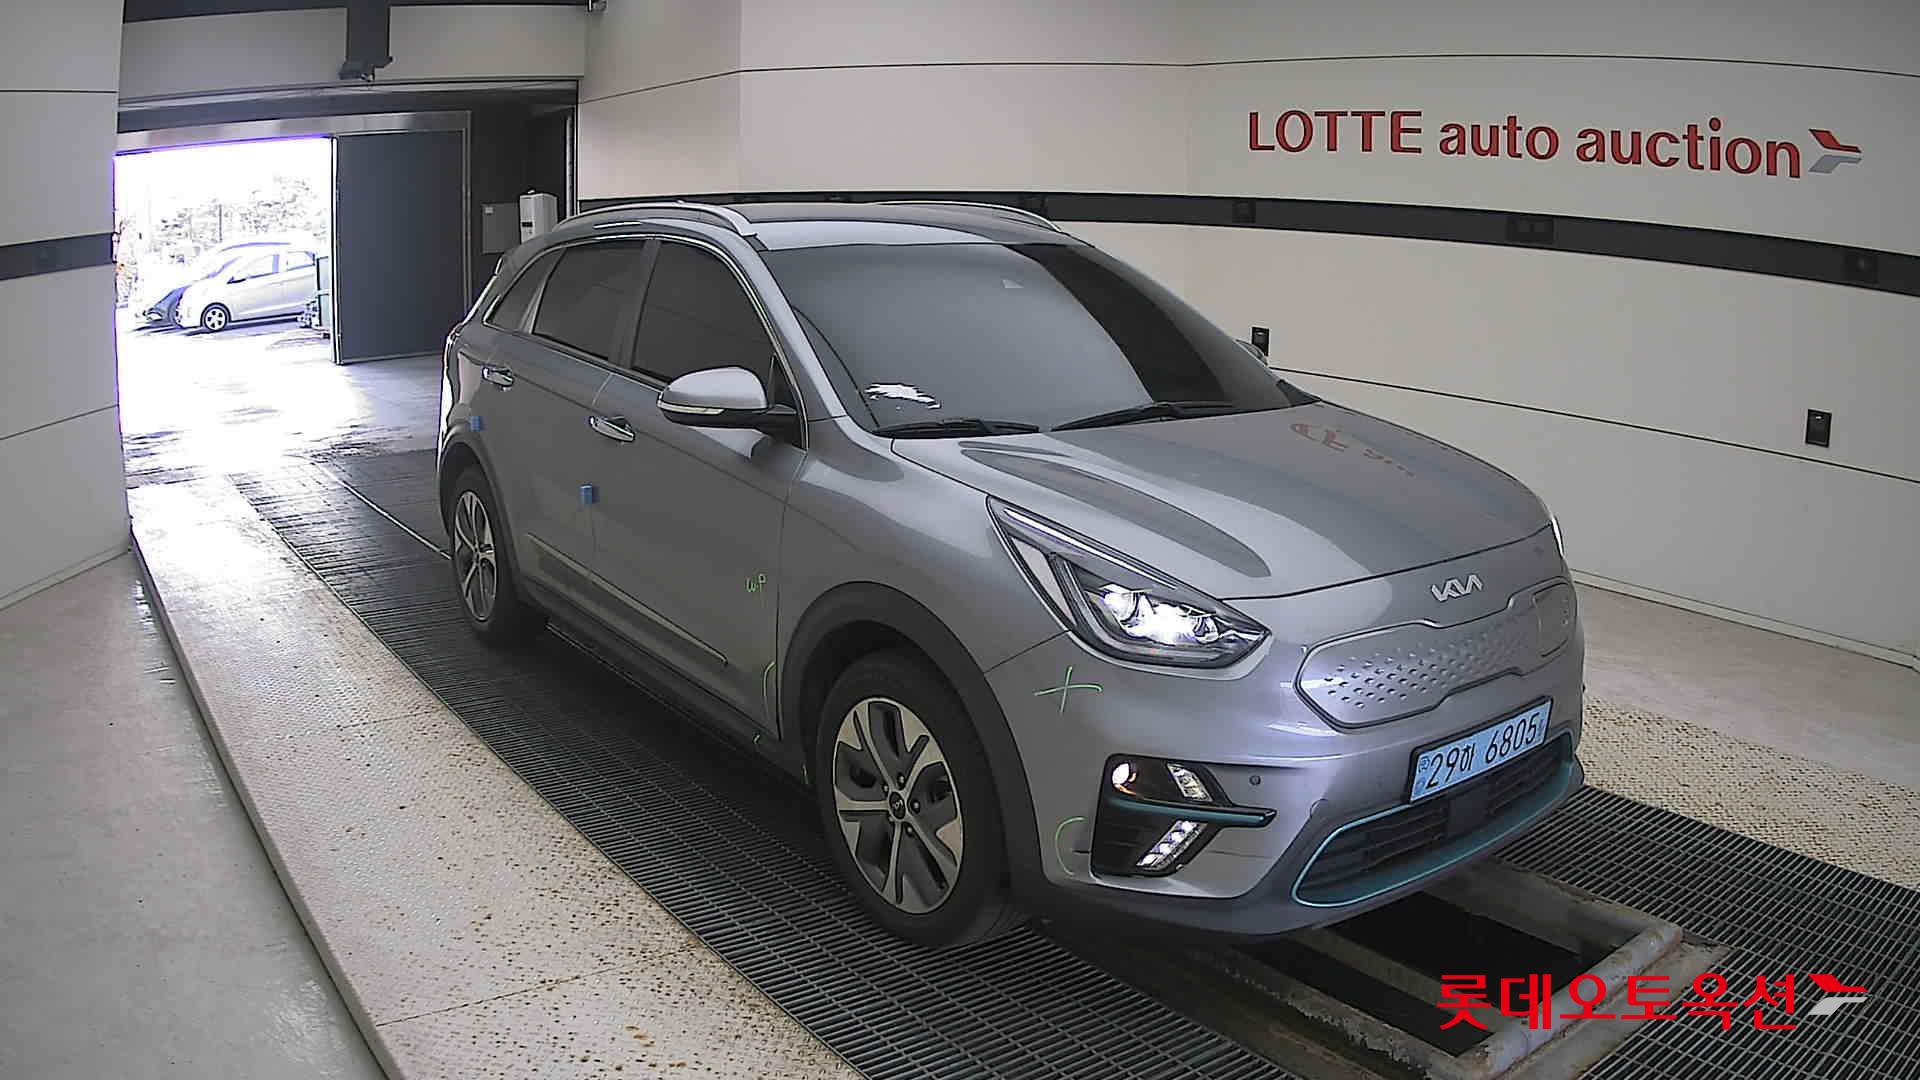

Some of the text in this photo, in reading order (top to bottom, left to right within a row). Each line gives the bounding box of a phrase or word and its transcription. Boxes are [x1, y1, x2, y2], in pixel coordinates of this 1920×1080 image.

[1248, 110, 1802, 179] LOTTE auto auction
[1425, 712, 1541, 790] 29하 6805
